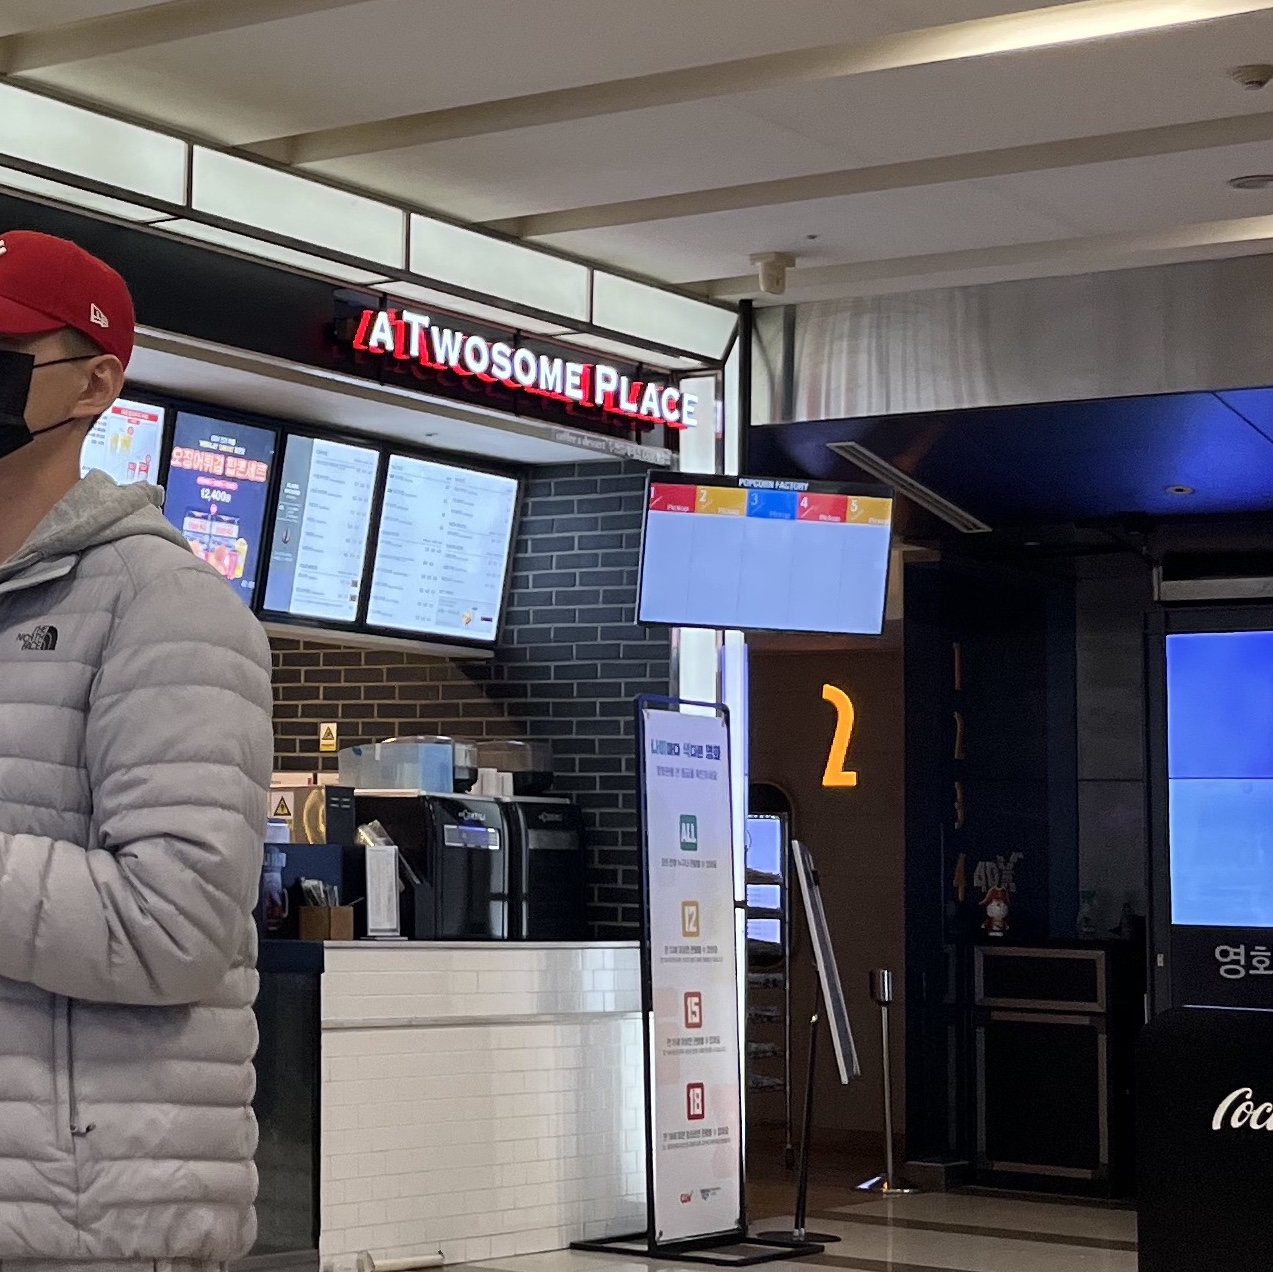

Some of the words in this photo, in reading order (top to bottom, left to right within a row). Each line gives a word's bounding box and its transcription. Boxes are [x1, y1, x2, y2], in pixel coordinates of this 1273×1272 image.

[368, 310, 396, 353] A
[402, 309, 585, 401] TWOSOME
[595, 363, 700, 428] PLACE
[738, 478, 775, 489] POPCORN
[775, 481, 809, 491] FACTORY
[822, 683, 858, 787] 2
[686, 994, 700, 1024] 15
